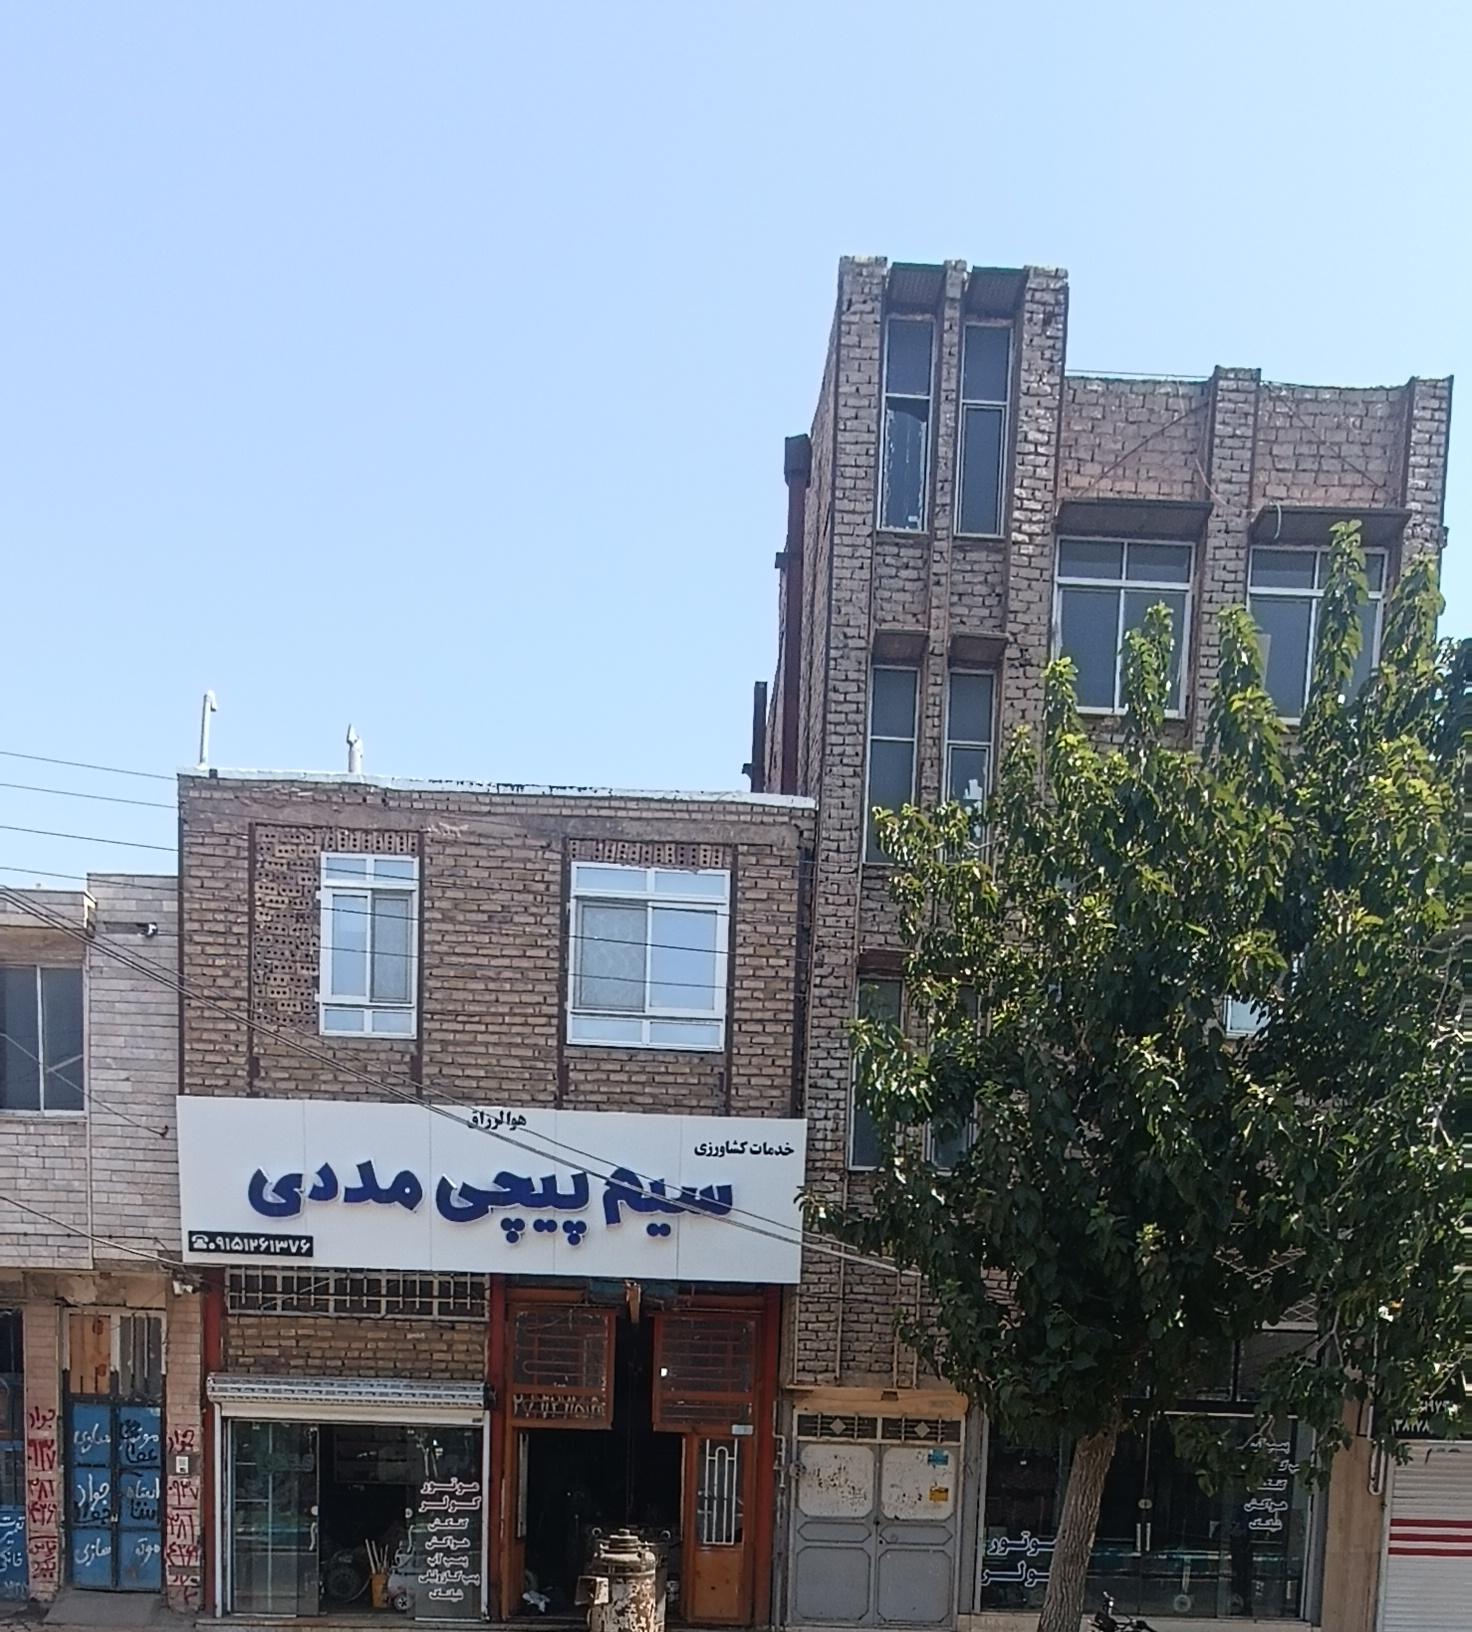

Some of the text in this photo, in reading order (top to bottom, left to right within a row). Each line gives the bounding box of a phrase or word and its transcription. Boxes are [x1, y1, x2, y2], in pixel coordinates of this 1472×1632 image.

[694, 1140, 795, 1158] خدمات کشاورزی
[247, 1158, 735, 1247] سیم پیچی مددی
[420, 1477, 480, 1496] موتور
[418, 1496, 482, 1512] کولر
[425, 1536, 471, 1551] هواکش
[987, 1530, 1057, 1556] وتور
[981, 1560, 1051, 1587] ولر
